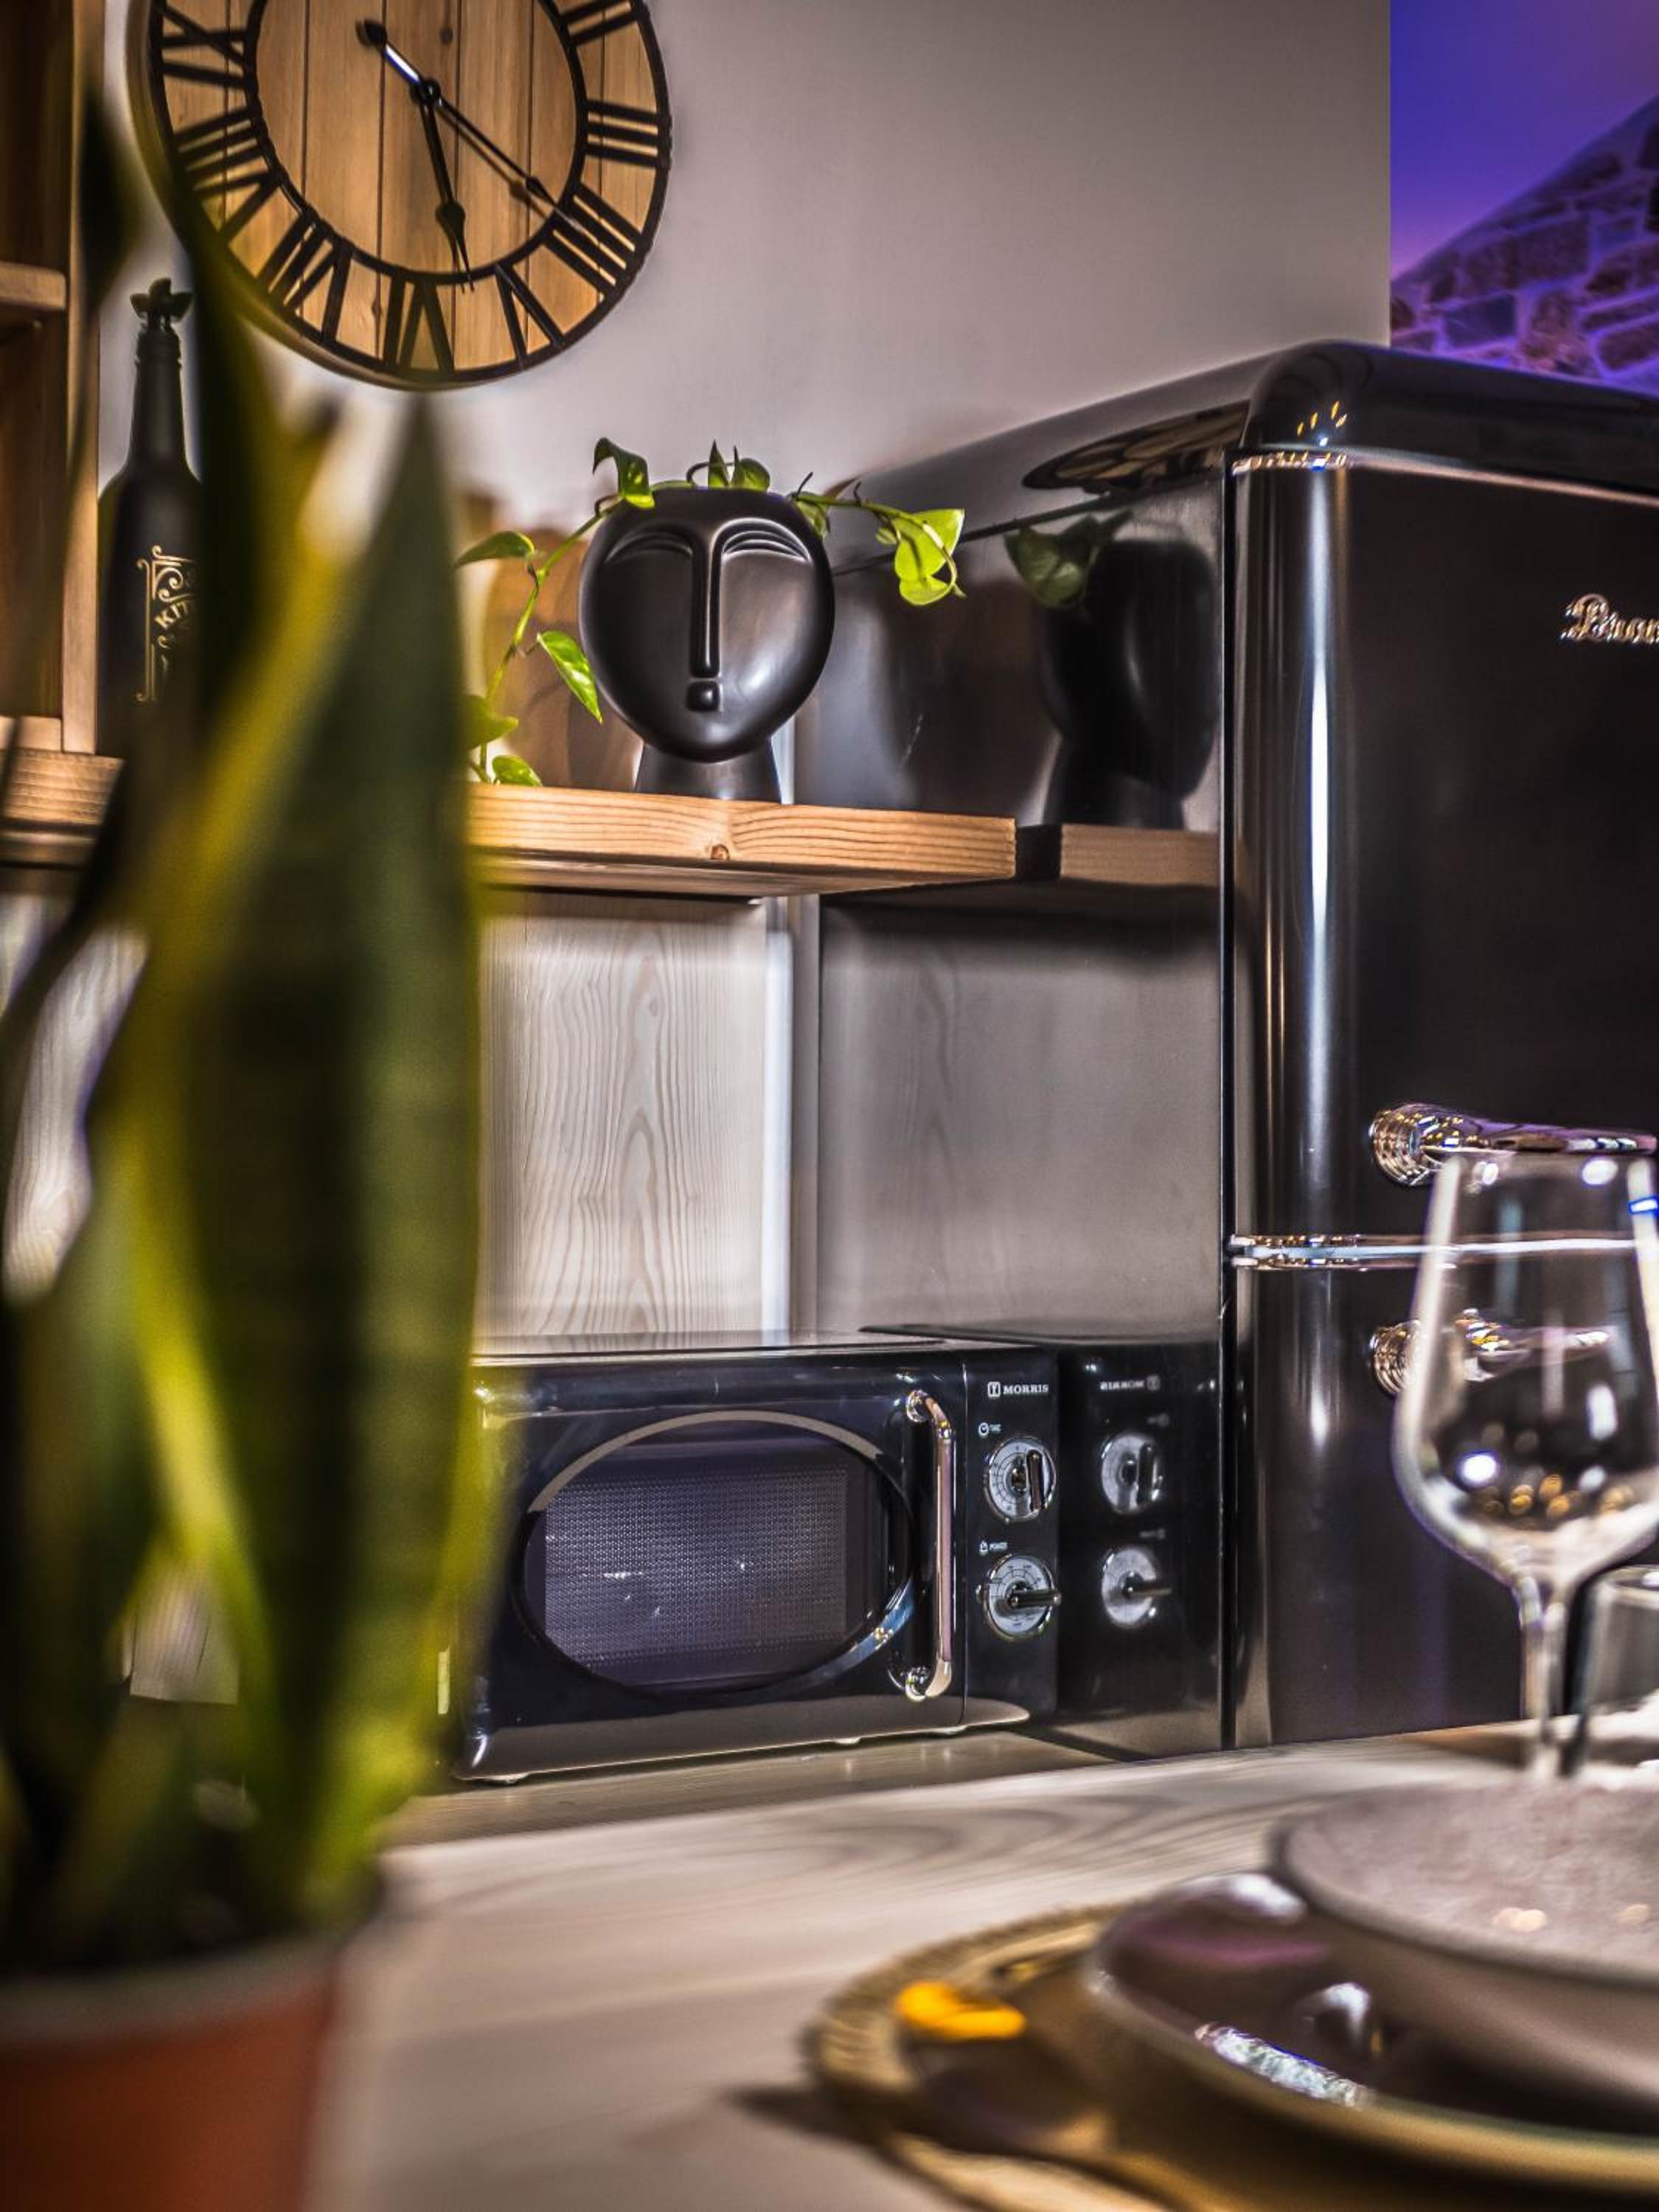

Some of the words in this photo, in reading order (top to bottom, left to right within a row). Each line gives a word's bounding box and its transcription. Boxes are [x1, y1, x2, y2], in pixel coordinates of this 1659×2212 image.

[587, 98, 661, 168] III
[383, 276, 455, 371] VI
[495, 263, 566, 368] V
[1003, 1384, 1049, 1394] MORRIS
